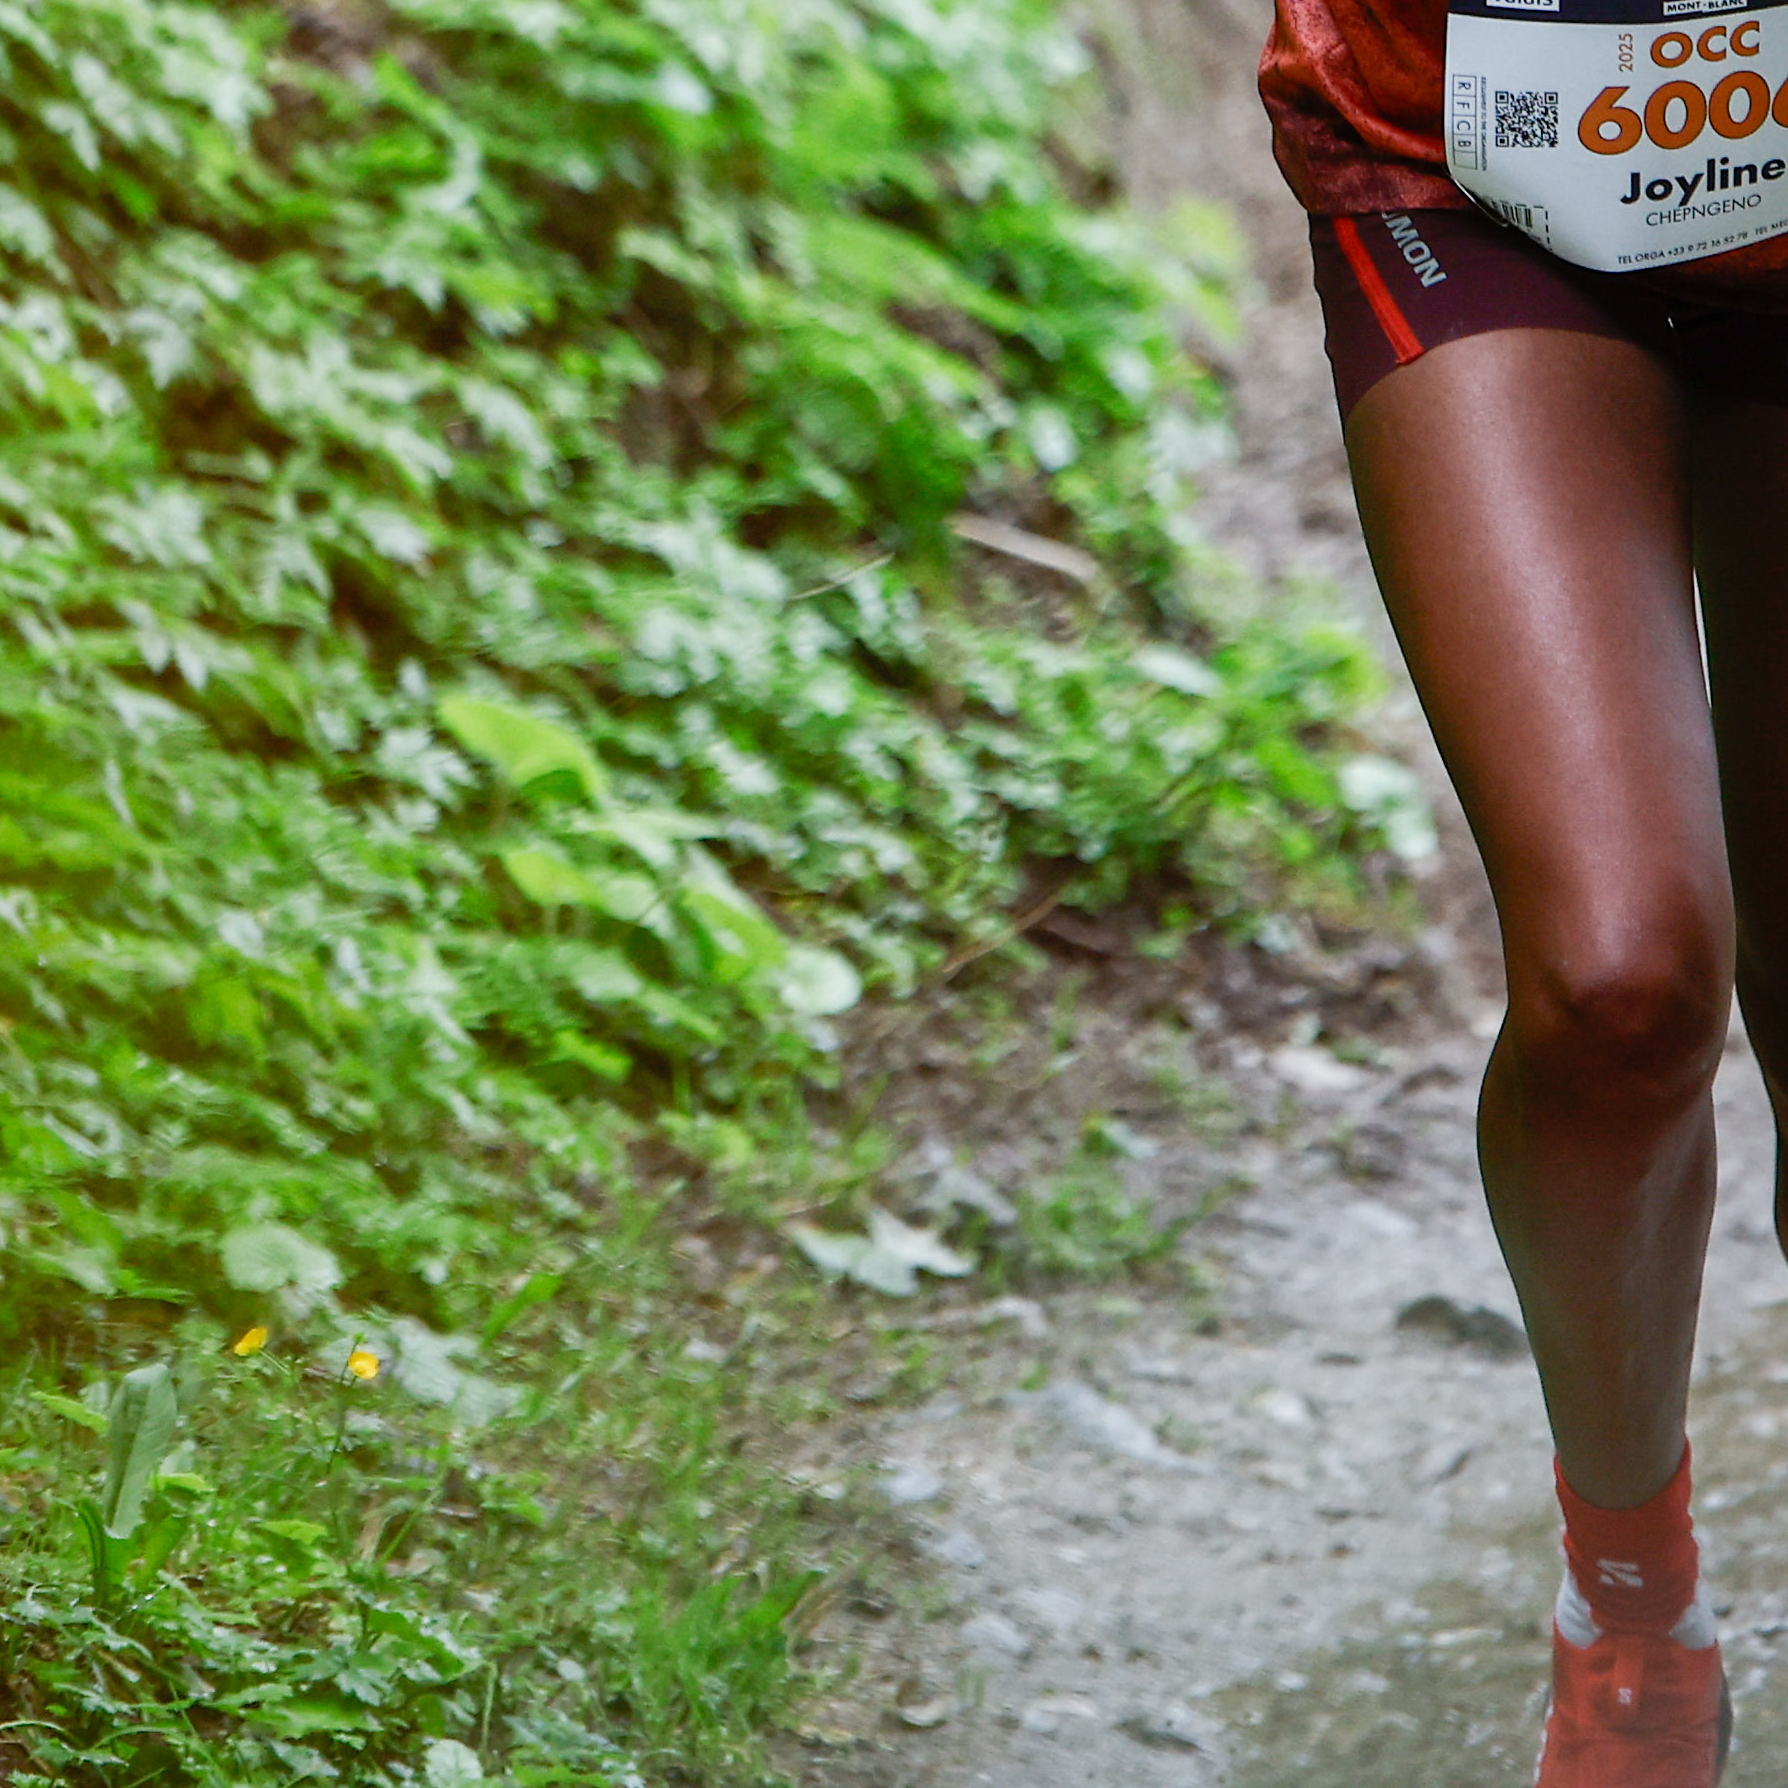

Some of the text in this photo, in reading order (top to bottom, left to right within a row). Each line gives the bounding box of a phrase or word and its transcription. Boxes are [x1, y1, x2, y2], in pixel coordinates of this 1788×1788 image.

[1618, 32, 1634, 73] 2025
[1650, 20, 1761, 69] OCC
[1620, 155, 1786, 207] Joyline
[1646, 194, 1762, 226] CHEPNGENO
[1381, 212, 1447, 288] MON
